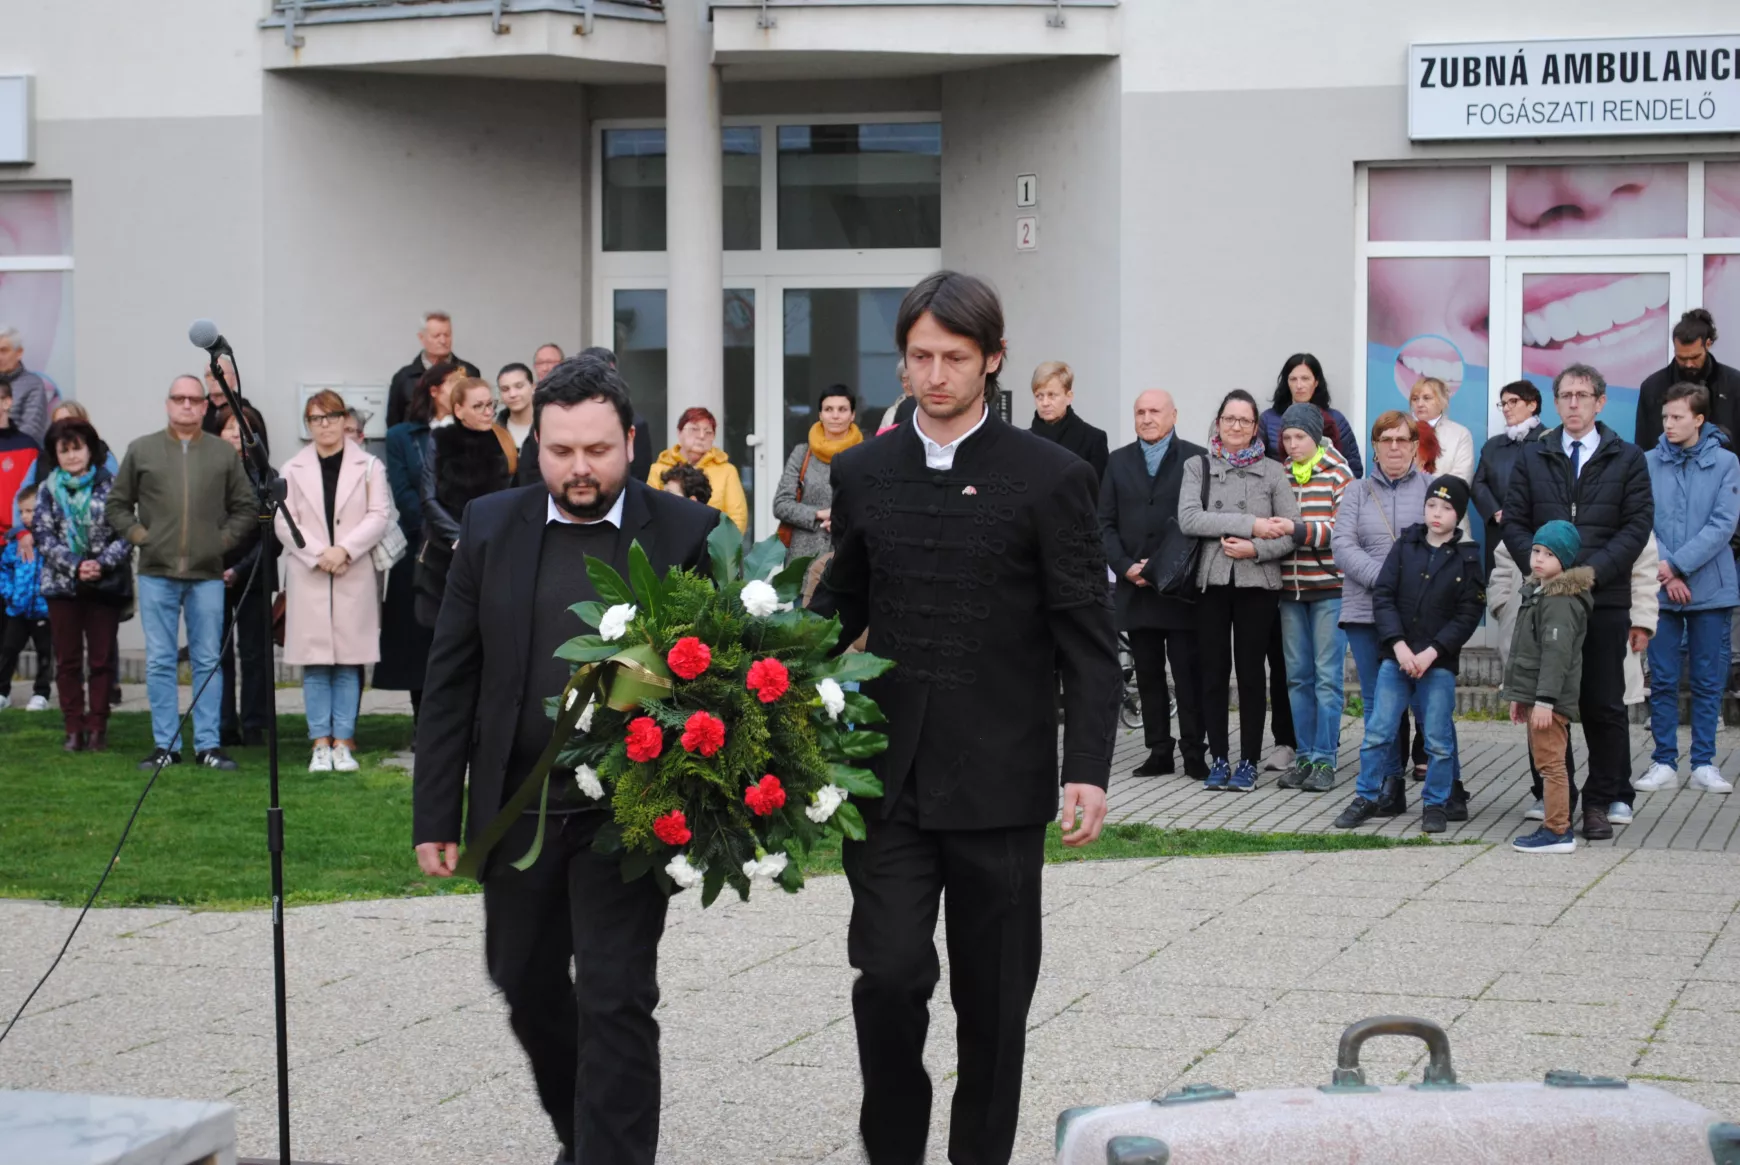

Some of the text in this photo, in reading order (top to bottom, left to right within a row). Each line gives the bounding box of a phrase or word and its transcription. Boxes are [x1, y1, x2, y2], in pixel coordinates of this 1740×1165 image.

[1420, 48, 1529, 89] ZUBNÁ
[1466, 91, 1716, 126] FOGÁSZATI RENDELŐ
[1024, 181, 1029, 202] 1
[1022, 222, 1030, 245] 2
